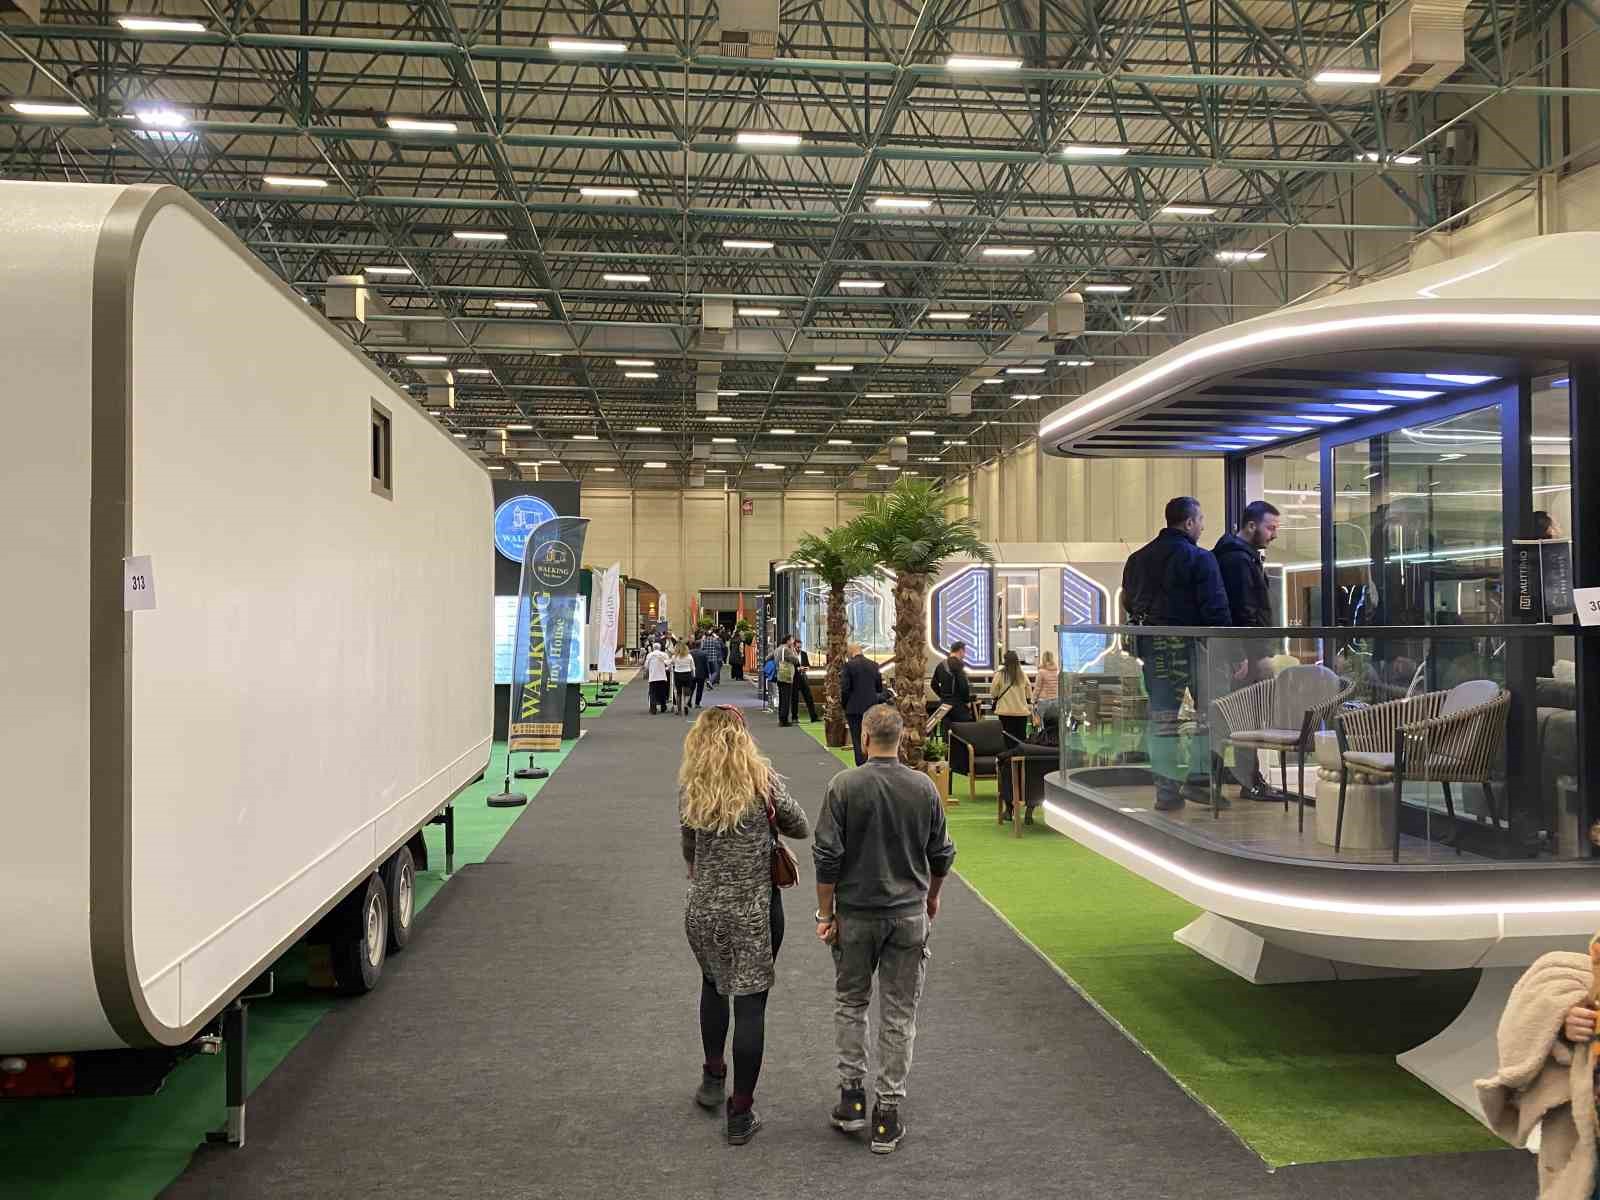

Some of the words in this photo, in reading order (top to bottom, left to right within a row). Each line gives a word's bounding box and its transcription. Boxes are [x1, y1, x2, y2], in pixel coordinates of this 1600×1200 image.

[132, 575, 146, 591] 313
[538, 565, 569, 576] WALKING
[550, 617, 566, 658] House
[521, 591, 551, 720] WALKING
[547, 662, 562, 692] Tiny
